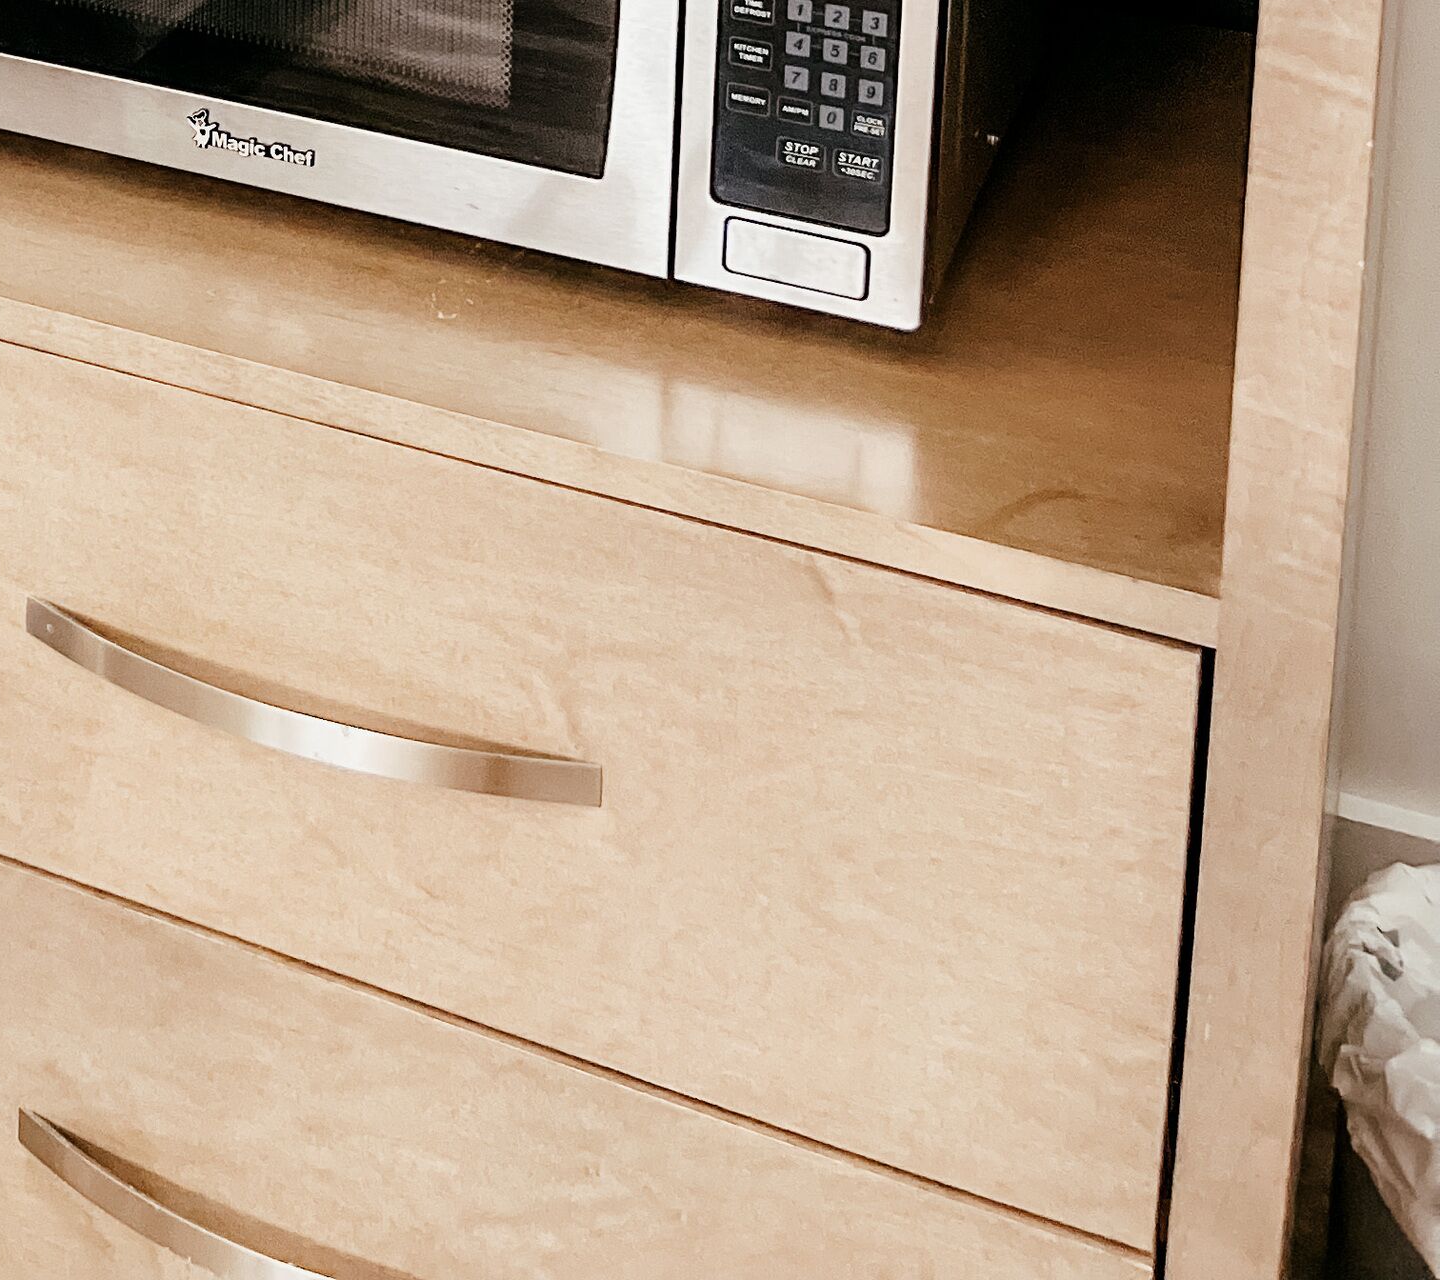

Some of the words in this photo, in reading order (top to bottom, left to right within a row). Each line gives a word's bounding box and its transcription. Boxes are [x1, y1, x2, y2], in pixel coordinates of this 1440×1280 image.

[796, 4, 804, 16] 1
[831, 10, 843, 23] 2
[869, 16, 880, 30] 3
[733, 42, 769, 56] KITCHEN
[793, 38, 804, 51] 4
[830, 44, 841, 58] 5
[738, 51, 764, 64] TIMER
[867, 51, 878, 65] 6
[791, 71, 802, 84] 7
[828, 78, 839, 92] 8
[731, 92, 766, 106] MEMORY
[866, 86, 876, 99] 9
[826, 111, 837, 124] 0
[856, 115, 883, 126] CLOCK
[211, 130, 266, 157] Magic
[269, 143, 314, 167] Chef
[784, 141, 819, 155] STOP
[785, 154, 816, 168] CLEAR
[838, 152, 880, 168] START
